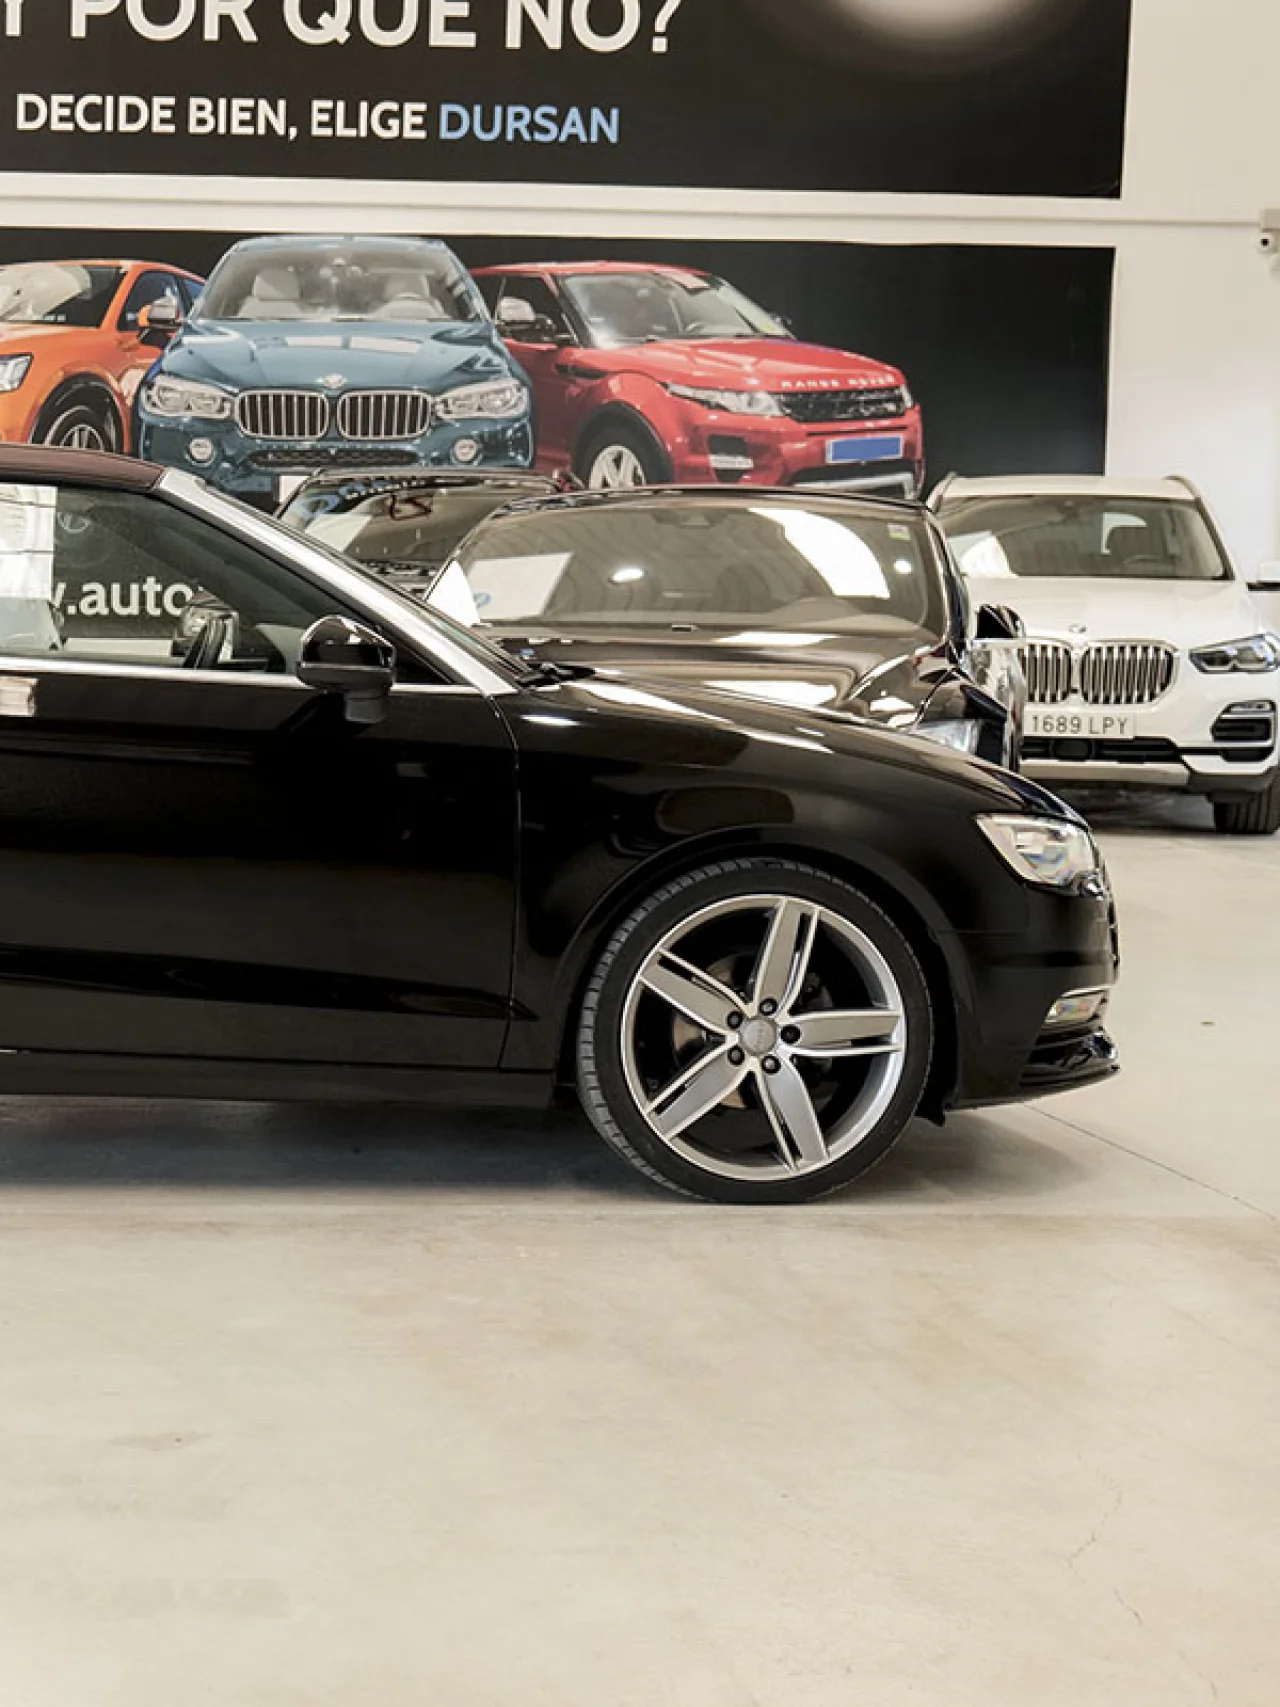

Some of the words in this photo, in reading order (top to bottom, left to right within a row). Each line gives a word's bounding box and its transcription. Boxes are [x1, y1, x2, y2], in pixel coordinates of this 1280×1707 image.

[70, 0, 258, 42] POR
[504, 0, 681, 53] NO?
[17, 93, 176, 133] DECIDE
[187, 97, 298, 141] BIEN,
[310, 99, 427, 140] ELIGE
[439, 103, 620, 144] DURSAN
[1032, 714, 1082, 735] 1689
[1088, 716, 1129, 735] LPY
